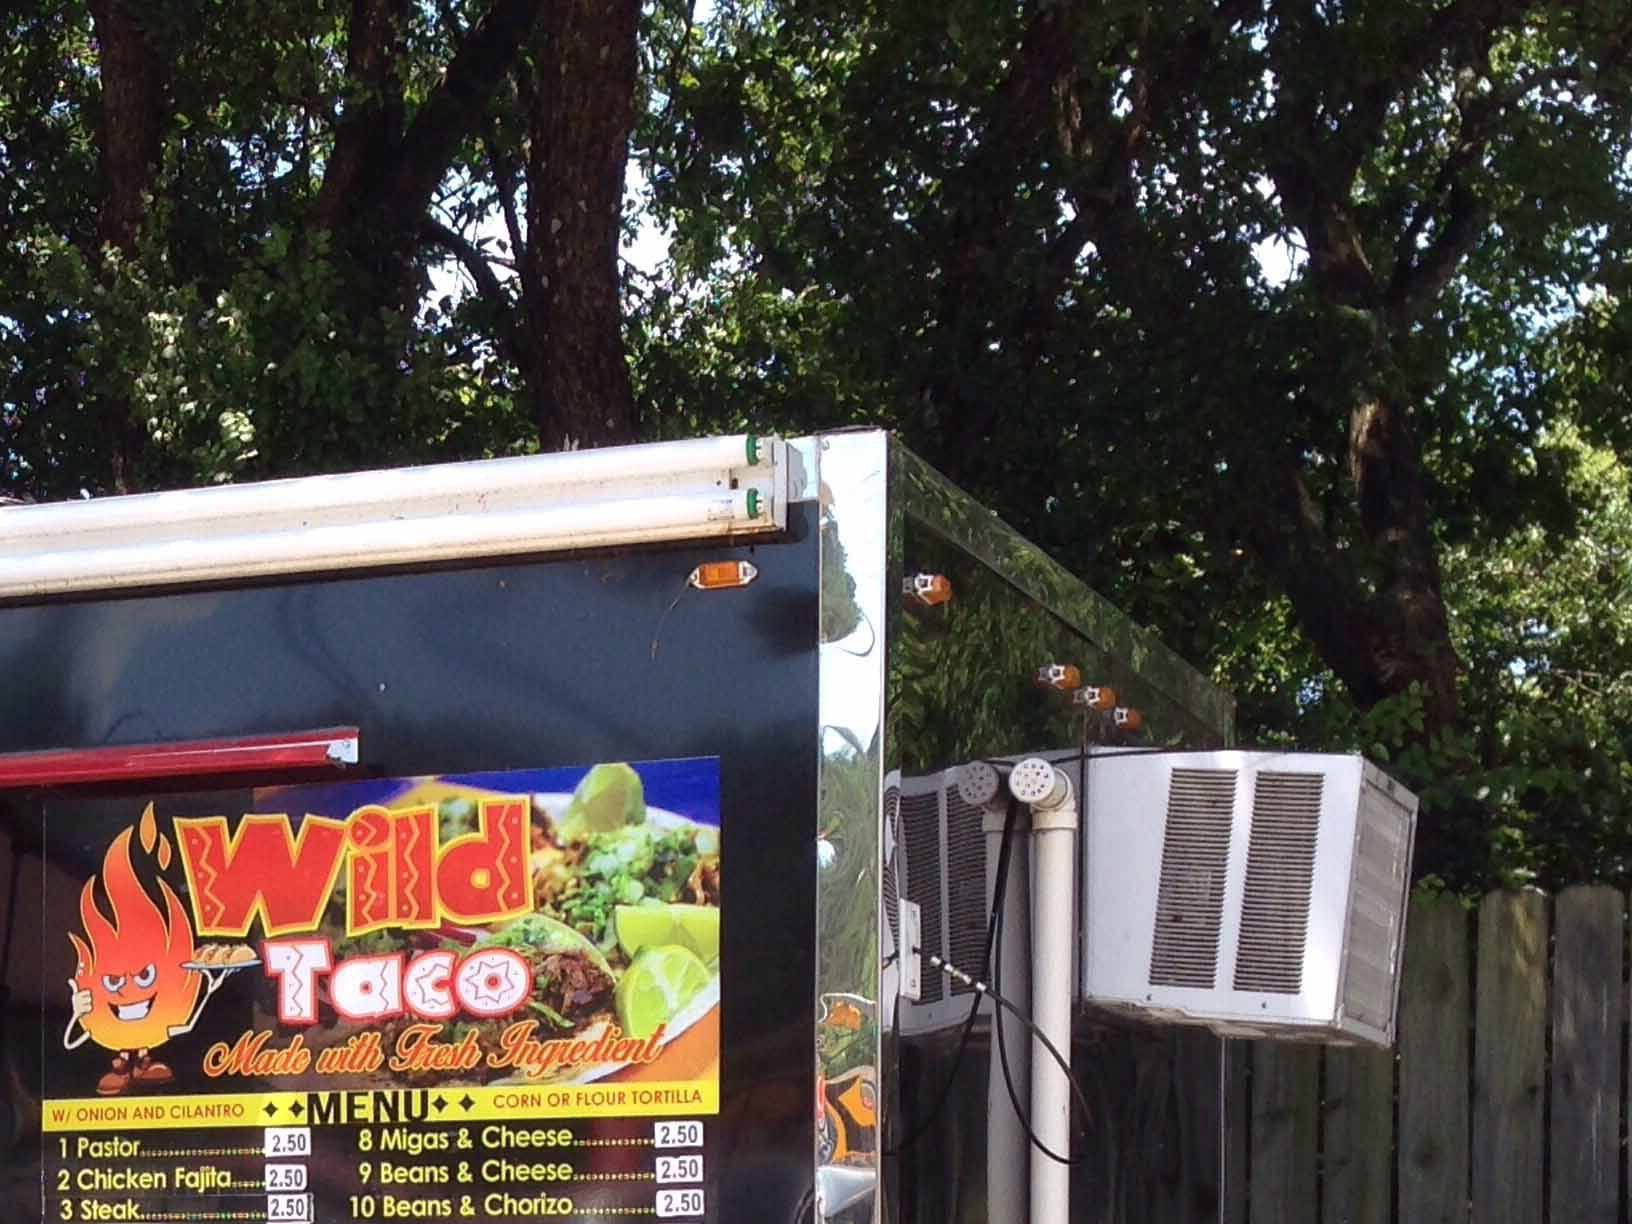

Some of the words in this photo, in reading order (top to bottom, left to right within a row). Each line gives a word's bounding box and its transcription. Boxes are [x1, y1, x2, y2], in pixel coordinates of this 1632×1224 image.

[173, 795, 534, 937] Wild
[261, 937, 531, 1026] Taco
[203, 1030, 309, 1079] Made
[316, 1034, 382, 1076] with
[390, 1026, 480, 1072] Fresh
[488, 1023, 667, 1079] Ingredient
[308, 1090, 428, 1125] MENU
[493, 1094, 541, 1108] CORN
[547, 1093, 570, 1107] OR
[576, 1092, 625, 1105] FLOUR
[632, 1090, 702, 1104] TORTILLA
[77, 1108, 127, 1122] ONION
[133, 1106, 164, 1120] AND
[170, 1104, 244, 1119] CILANTRO
[59, 1138, 68, 1158] 1
[77, 1138, 140, 1158] Pastor
[272, 1133, 306, 1152] 2.50
[359, 1131, 372, 1150] 8
[380, 1129, 449, 1155] Migas
[457, 1129, 472, 1149] &
[482, 1126, 573, 1148] Cheese
[661, 1124, 698, 1144] 2.50
[57, 1171, 70, 1189] 2
[77, 1169, 166, 1189] Chicken
[175, 1168, 232, 1193] Fajita
[269, 1169, 303, 1187] 2.50
[359, 1164, 371, 1184] 9
[380, 1163, 449, 1183] Beans
[457, 1162, 472, 1182] &
[482, 1160, 573, 1182] Cheese
[661, 1159, 698, 1178] 2.50
[60, 1200, 73, 1219] 3
[81, 1199, 141, 1219] Steak
[271, 1199, 304, 1217] 2.50
[350, 1197, 374, 1217] 10
[383, 1197, 452, 1216] Beans
[460, 1196, 474, 1216] &
[484, 1193, 573, 1216] Chorizo
[664, 1193, 701, 1212] 2.50
